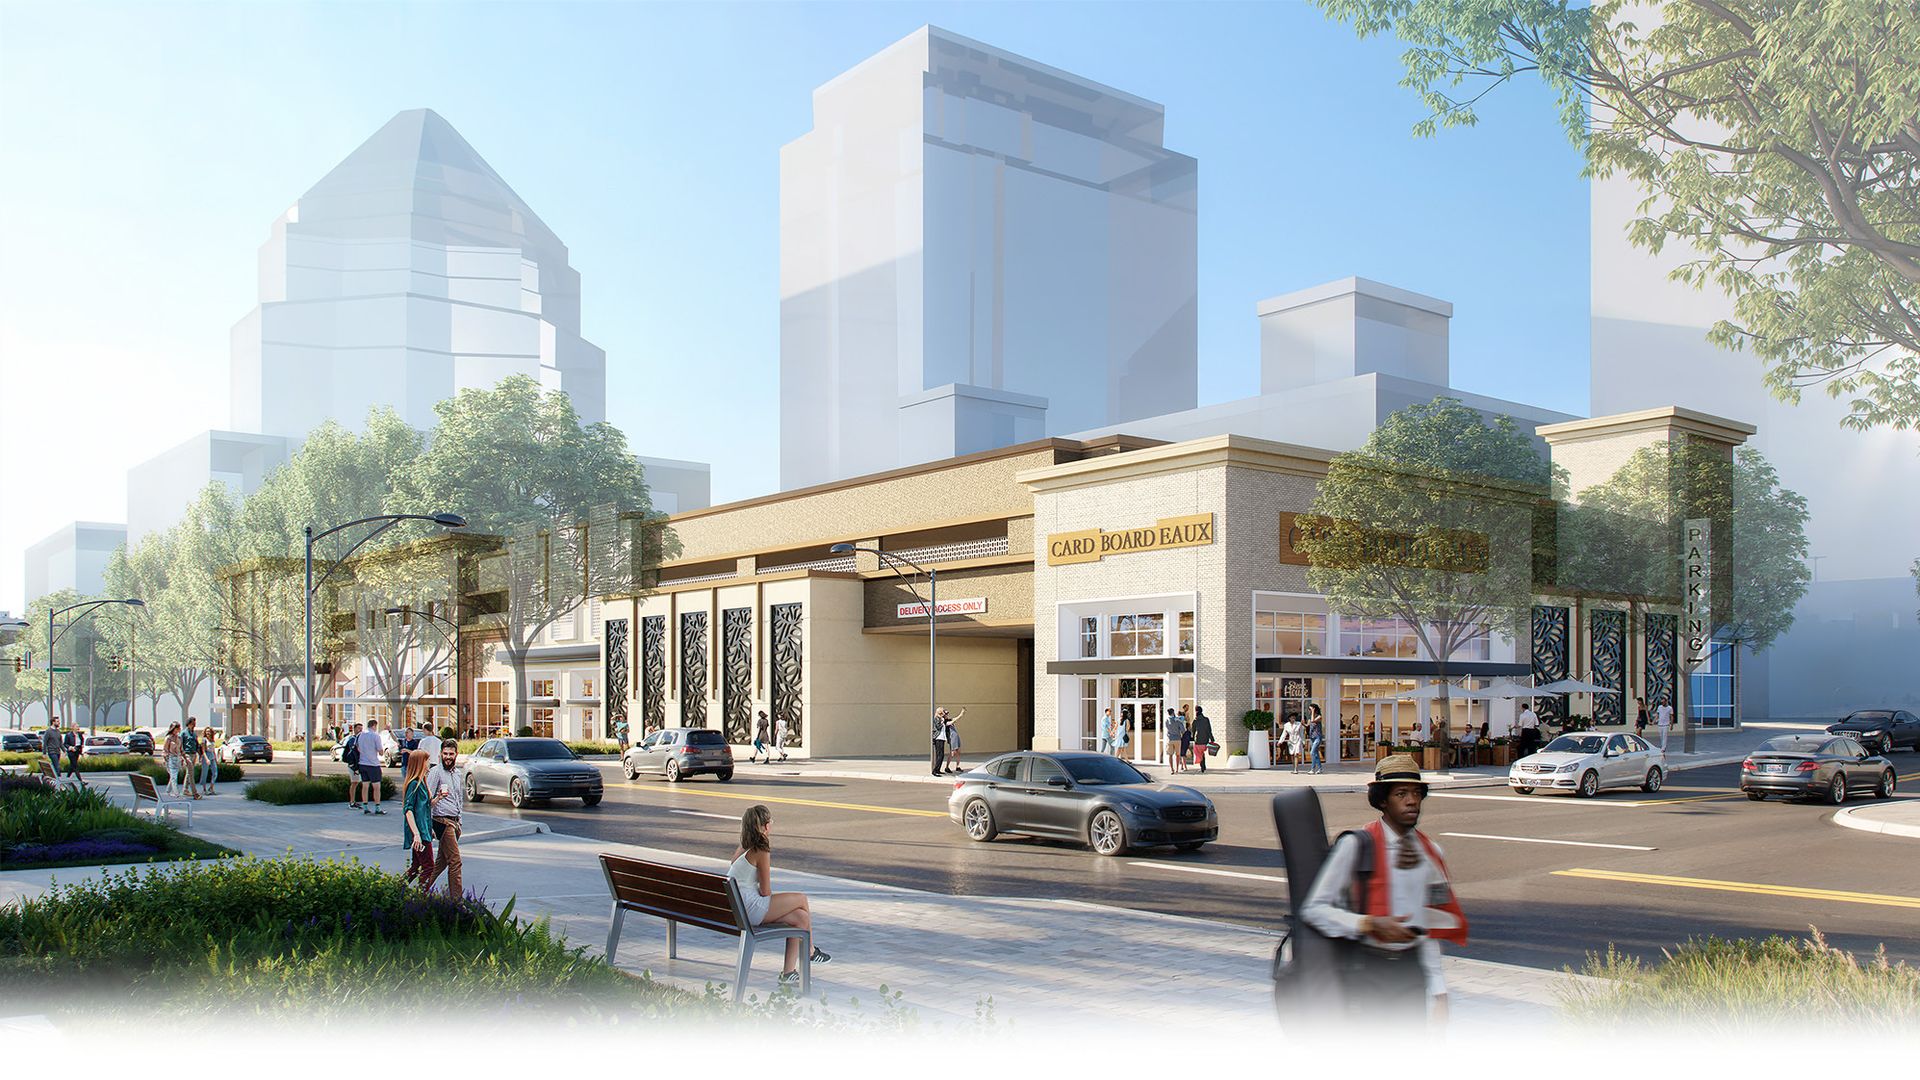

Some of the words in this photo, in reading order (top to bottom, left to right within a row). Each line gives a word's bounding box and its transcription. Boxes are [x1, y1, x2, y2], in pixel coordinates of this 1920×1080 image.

[1051, 537, 1095, 558] CARD
[1101, 529, 1156, 552] BOARD
[1160, 522, 1211, 546] EAUX
[963, 601, 982, 611] ONLY
[1688, 528, 1702, 651] PARKING
